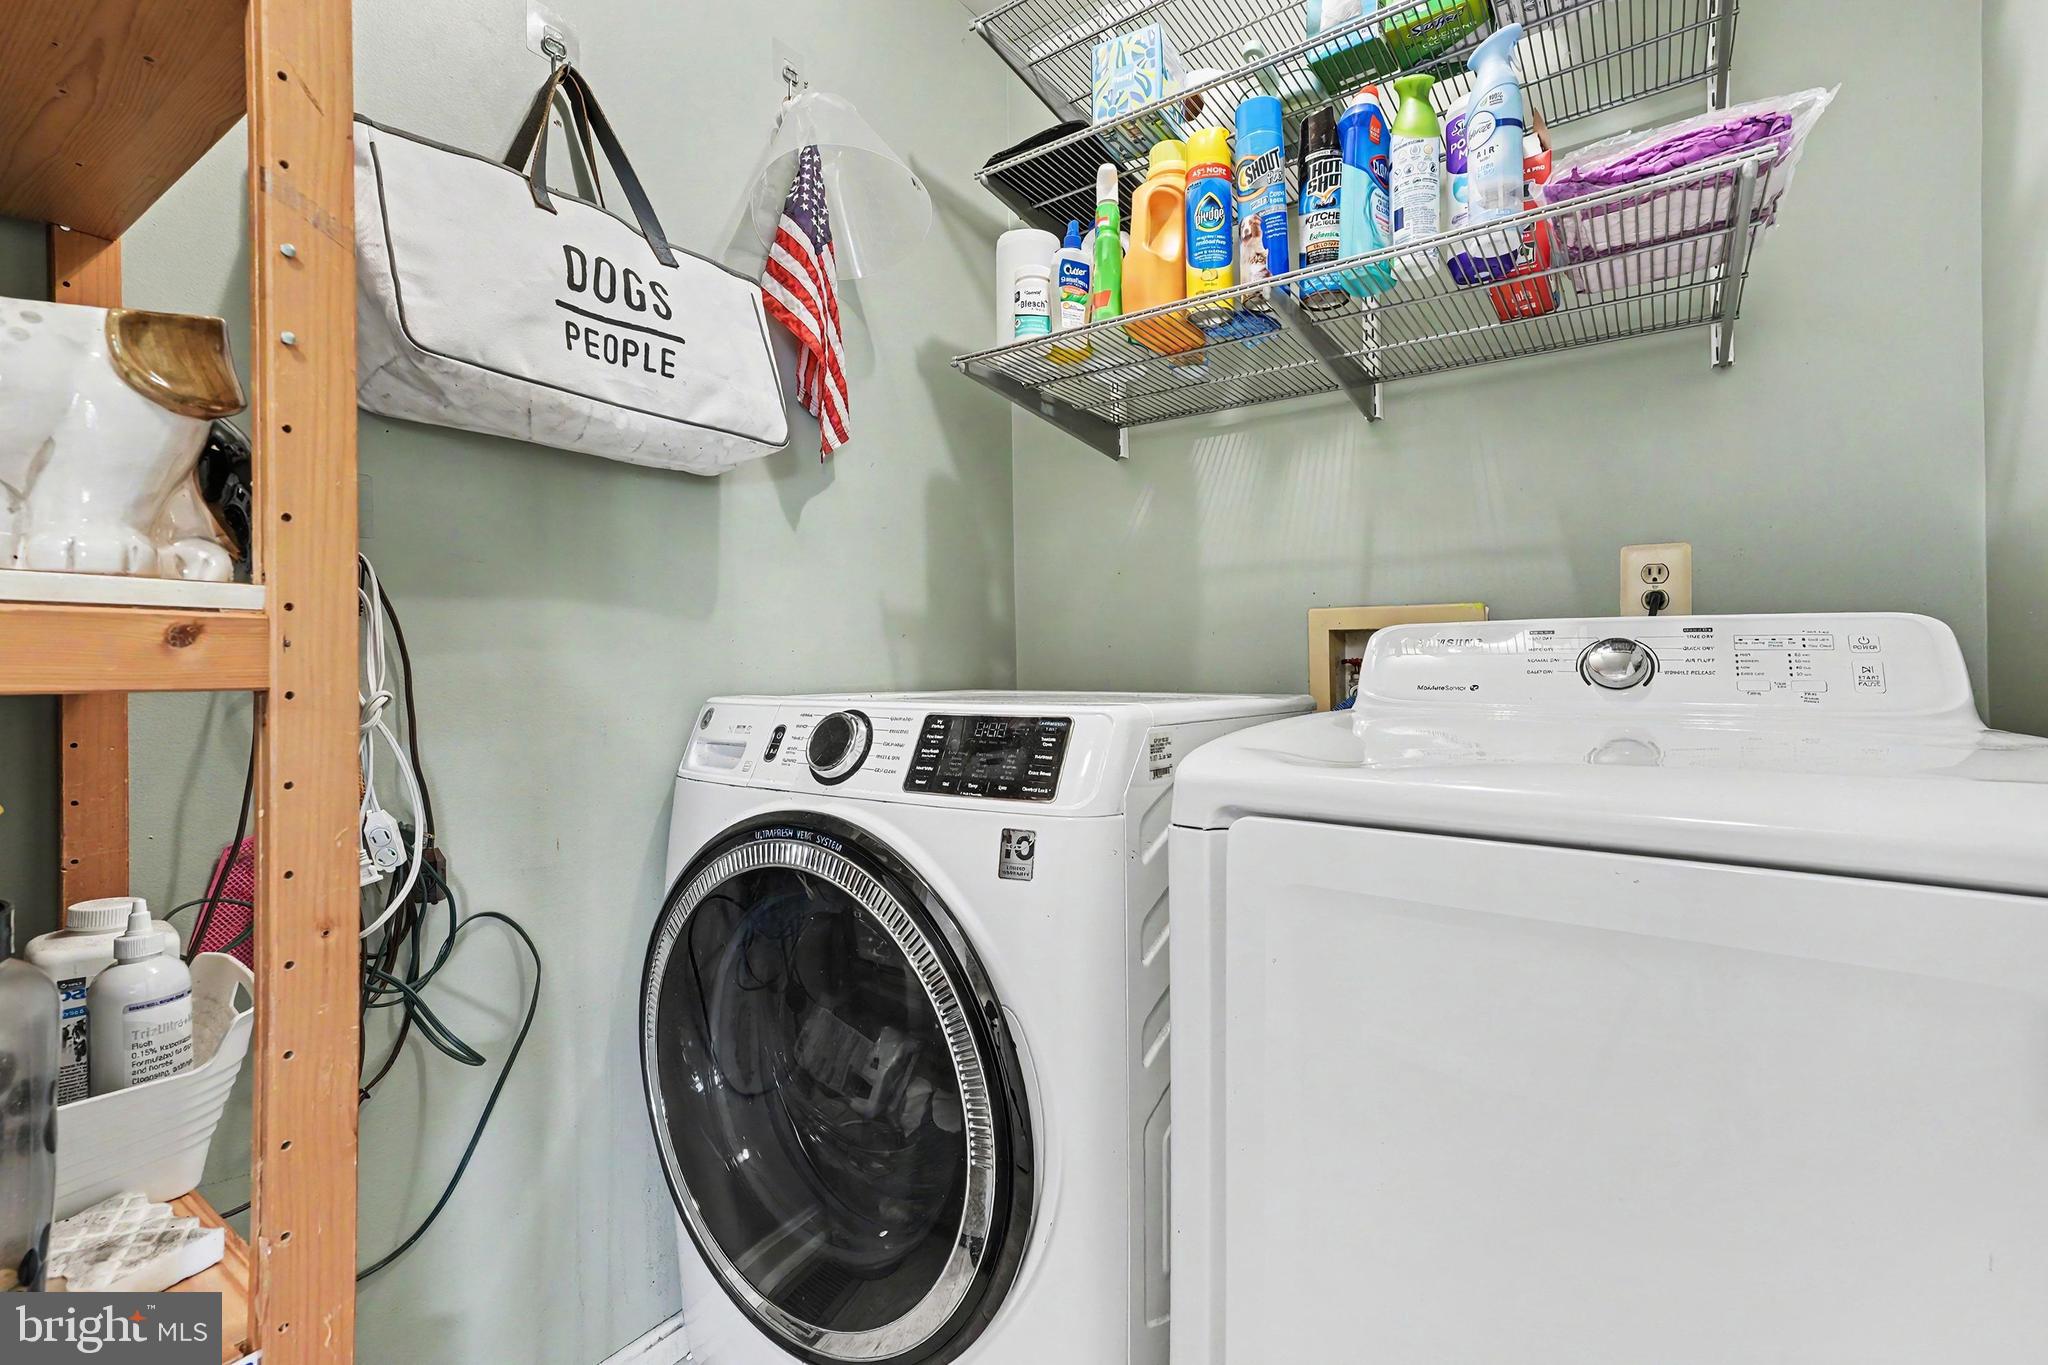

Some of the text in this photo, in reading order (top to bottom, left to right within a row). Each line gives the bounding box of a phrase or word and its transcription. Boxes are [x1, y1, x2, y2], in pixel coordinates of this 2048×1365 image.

[1307, 173, 1342, 194] SHO
[563, 244, 672, 320] DOGS
[565, 320, 676, 378] PEOPLE
